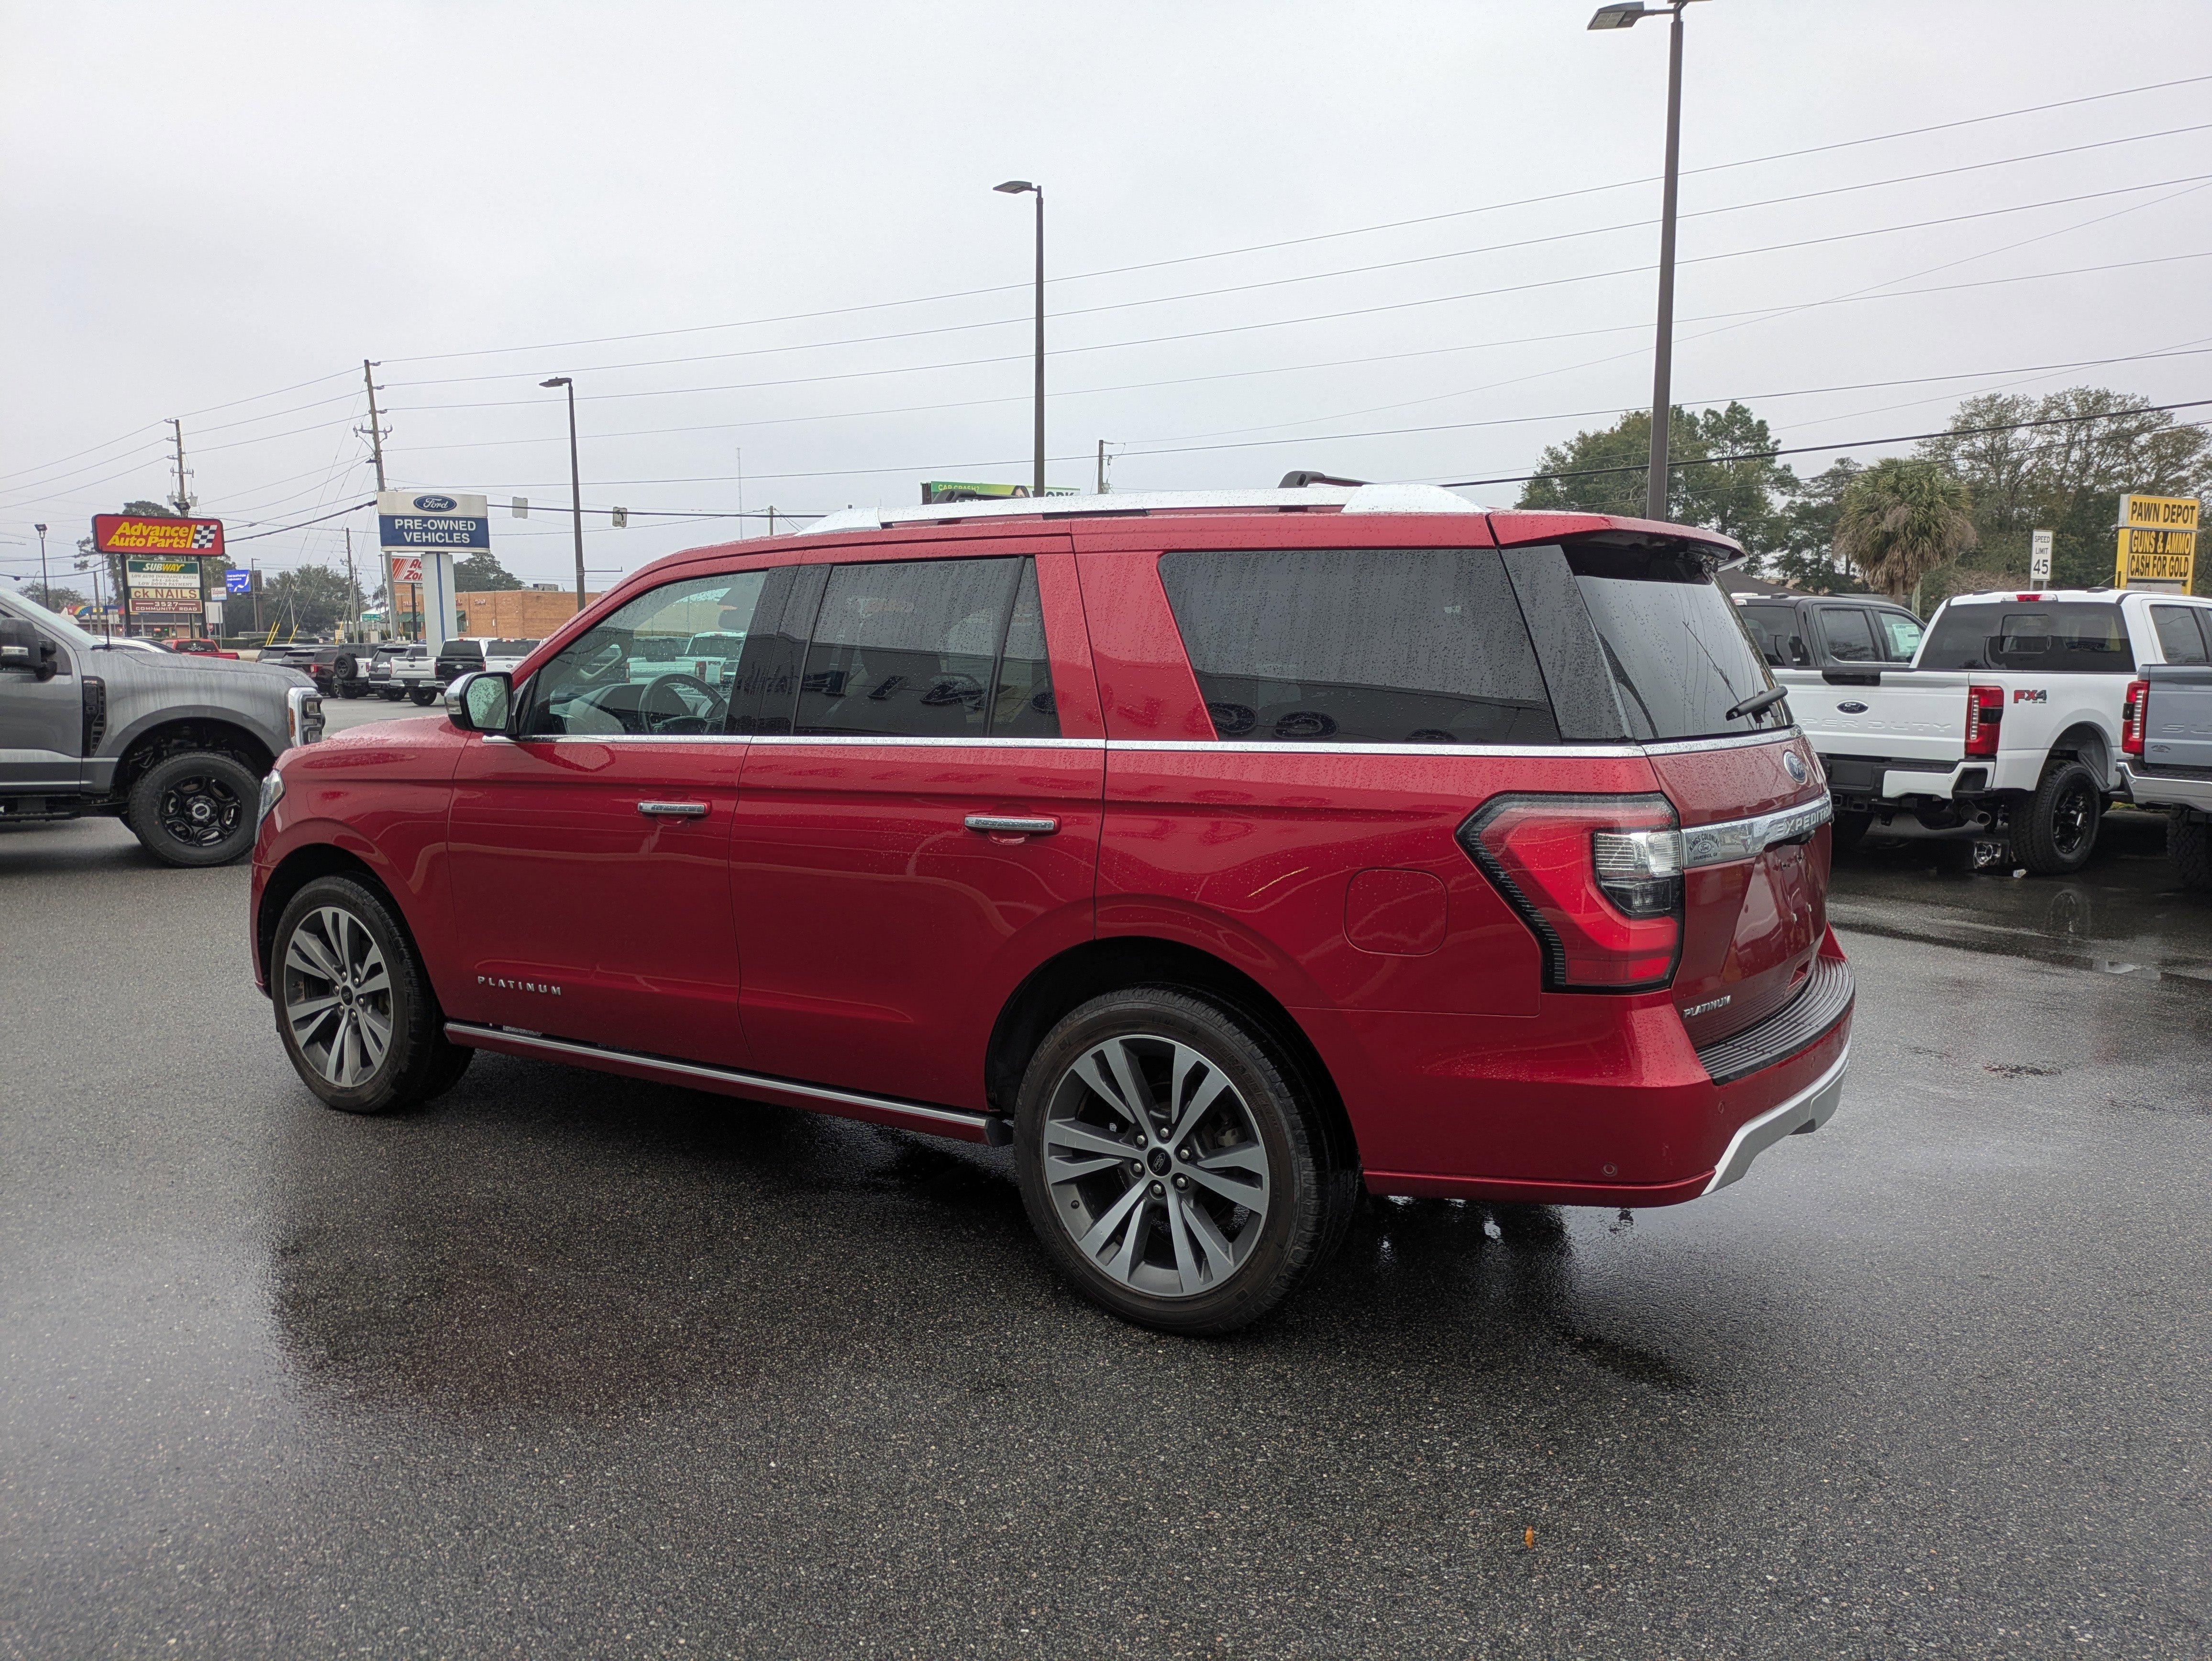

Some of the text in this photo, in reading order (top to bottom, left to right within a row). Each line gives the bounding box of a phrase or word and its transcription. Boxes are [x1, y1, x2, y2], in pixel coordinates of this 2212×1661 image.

[423, 498, 449, 509] Ford
[2131, 501, 2196, 524] PAWN DEPOT
[115, 522, 190, 537] Advance
[395, 519, 476, 531] PRE-OWNED
[107, 535, 187, 548] Auto Parts
[403, 532, 470, 543] VEHICLES
[2132, 530, 2191, 554] GUNS & AMMO
[143, 563, 185, 572] SUBWAY
[2033, 559, 2048, 574] 45
[2130, 554, 2189, 577] CASH FOR GOLD
[155, 589, 197, 598] NAILS
[2013, 690, 2047, 704] FX4
[1843, 702, 1860, 711] Ford
[1868, 720, 1952, 732] DUTY
[1689, 833, 1720, 852] KINGS COLONIAL
[477, 976, 561, 996] PLATINUM
[1682, 995, 1731, 1019] PLATINUM
